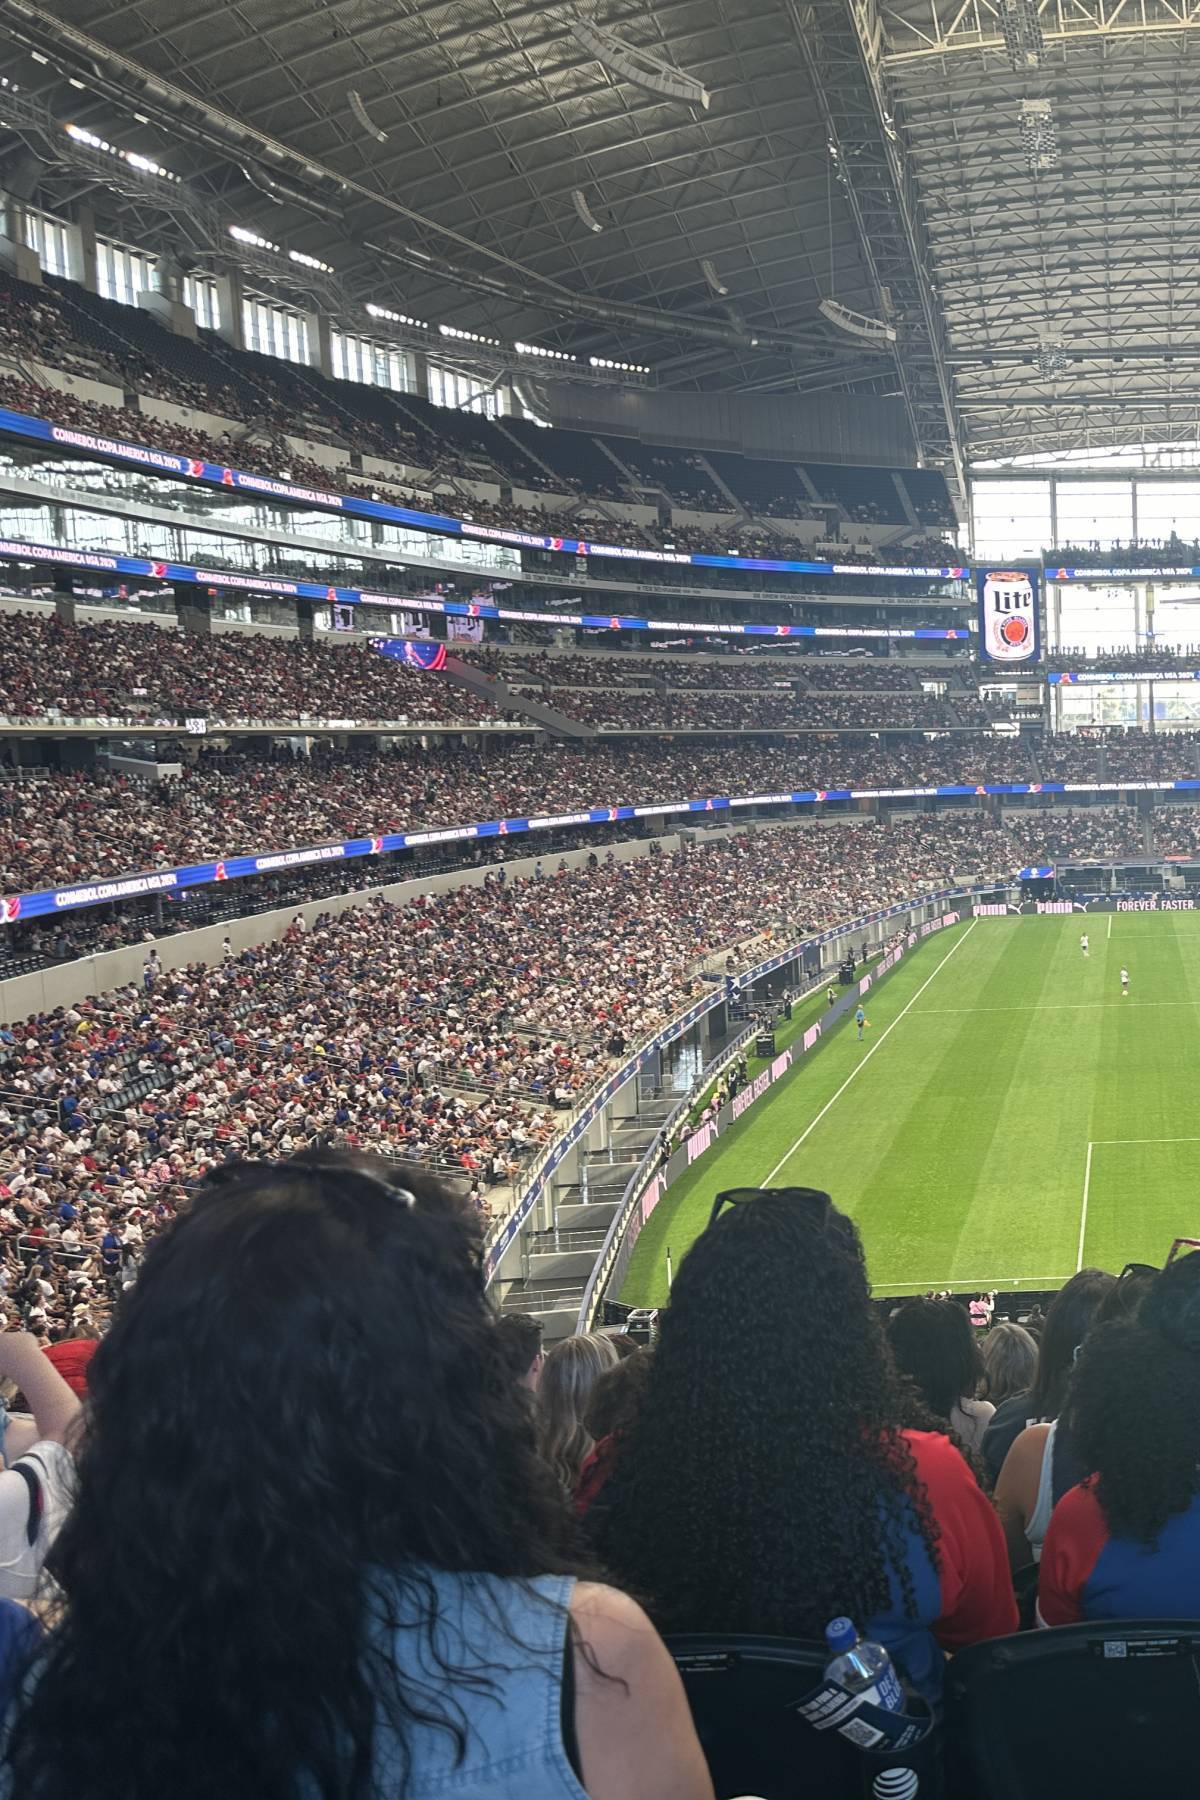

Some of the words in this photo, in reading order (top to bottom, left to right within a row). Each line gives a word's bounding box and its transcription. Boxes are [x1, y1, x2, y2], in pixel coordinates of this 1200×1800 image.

[993, 591, 1031, 614] Lite
[973, 903, 1007, 916] PUMA
[1037, 902, 1072, 914] PUMA
[1116, 900, 1159, 912] FOREVER.
[1161, 899, 1197, 910] FASTER.
